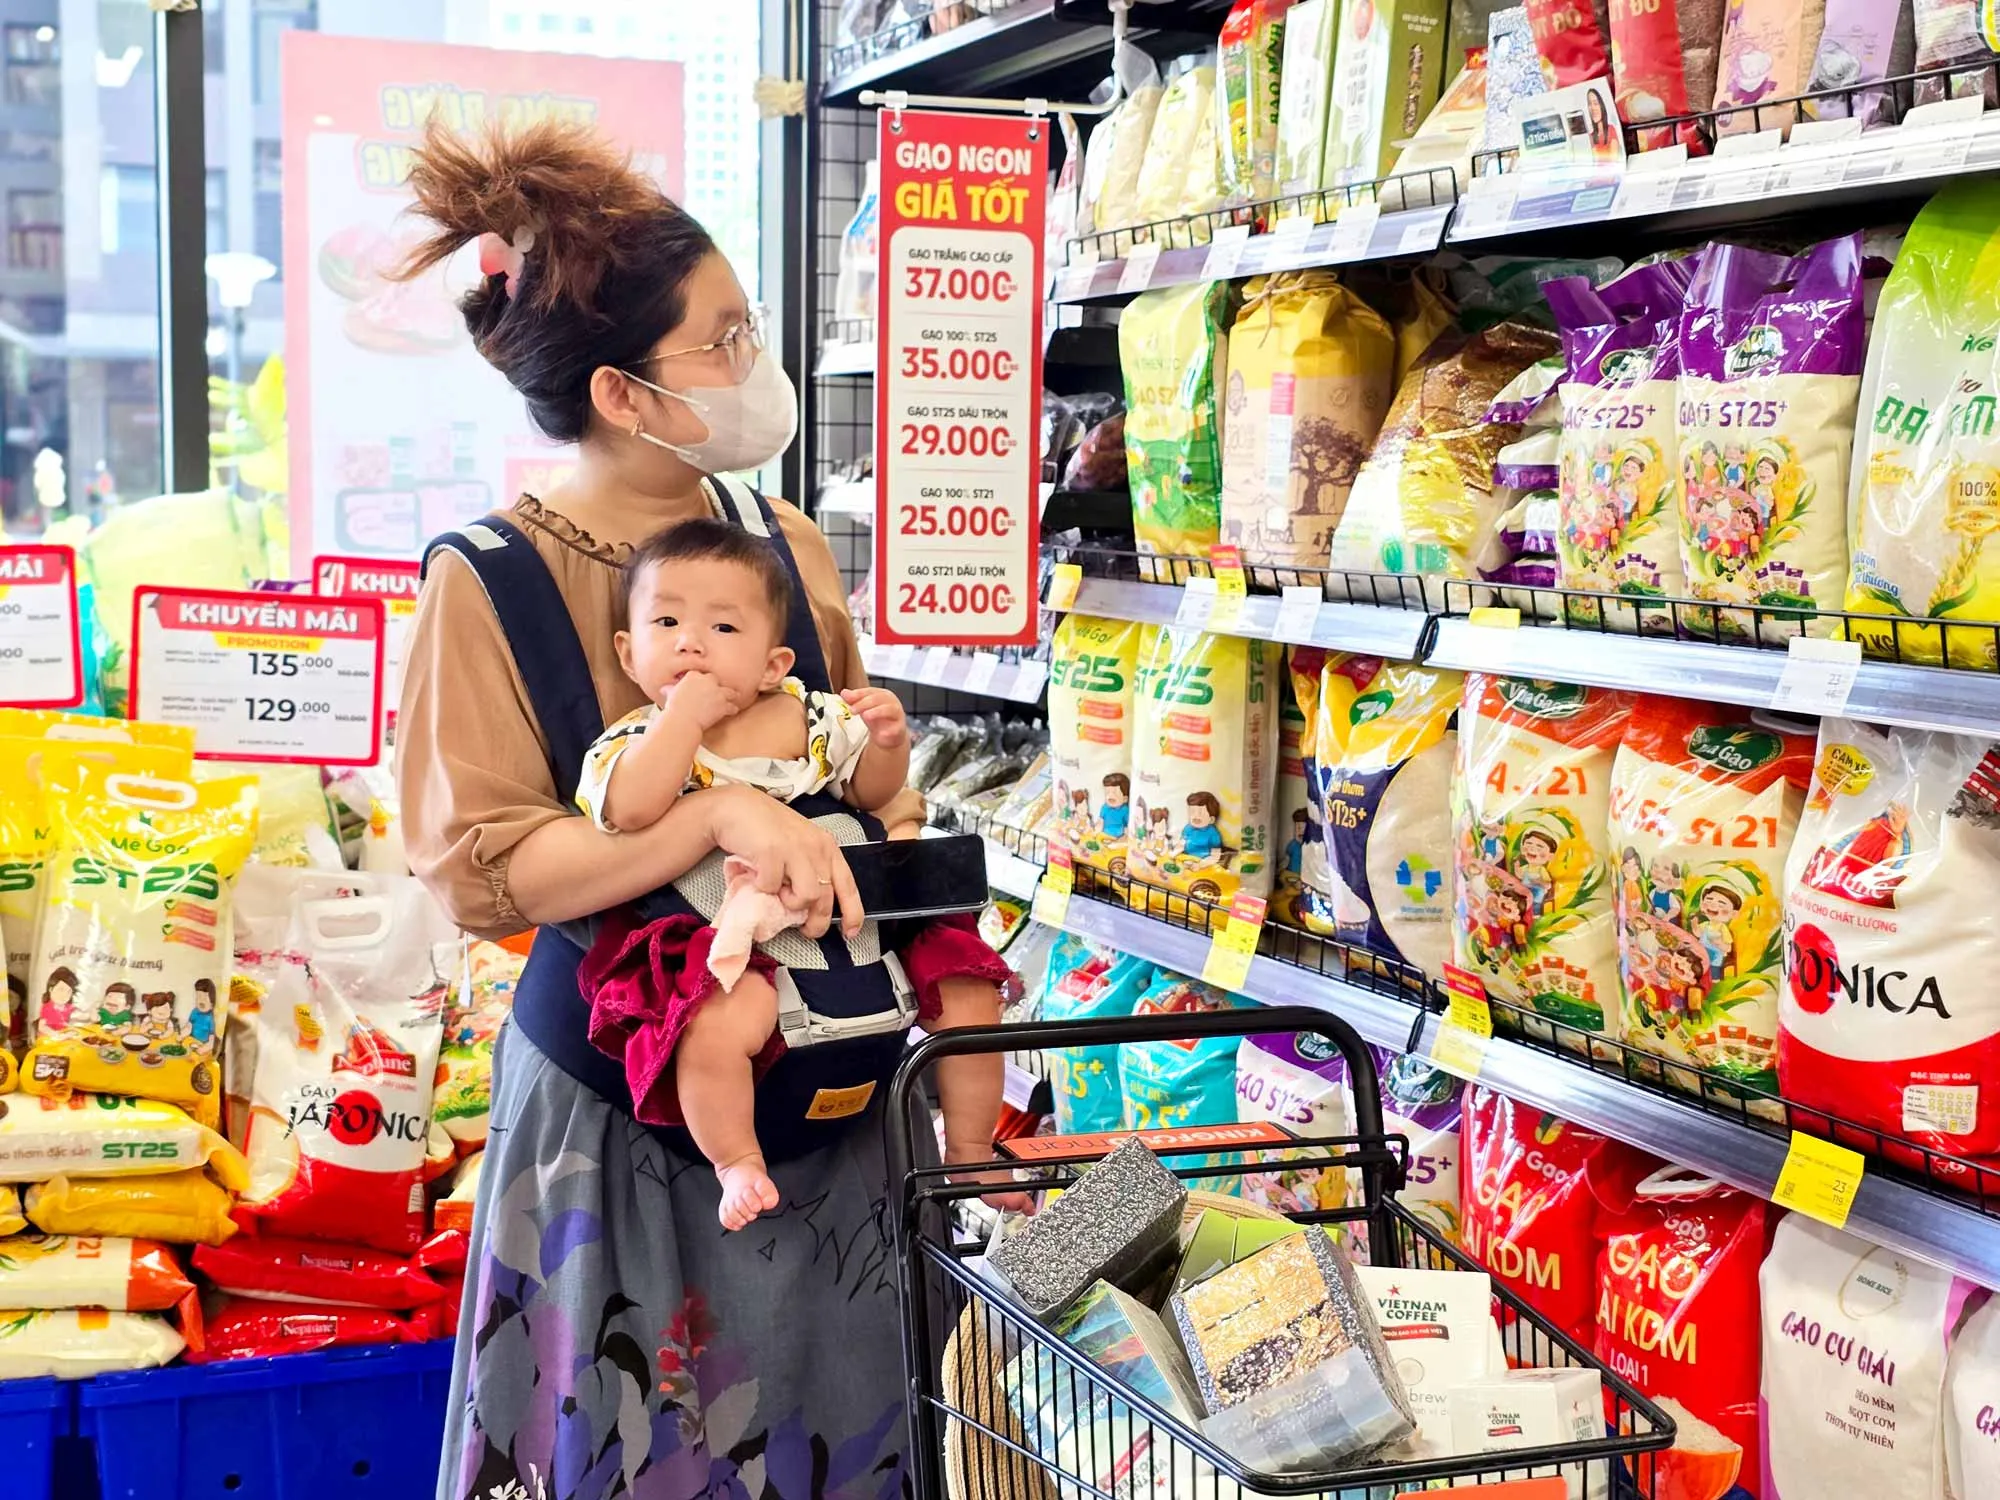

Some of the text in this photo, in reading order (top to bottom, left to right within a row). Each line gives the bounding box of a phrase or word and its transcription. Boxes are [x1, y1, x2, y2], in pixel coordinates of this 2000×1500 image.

[895, 141, 1032, 175] GẠO NGON
[895, 175, 1030, 224] GIÁ TỐT
[969, 251, 990, 262] CAO
[973, 331, 998, 343] ST25
[932, 406, 956, 418] ST25
[1719, 400, 1788, 428] ST25+
[973, 488, 994, 499] ST21
[1958, 481, 1997, 497] 100%
[932, 565, 954, 576] ST21
[351, 572, 420, 595] KHUY
[179, 601, 359, 633] KHUYẾN MÃI
[226, 636, 311, 651] PROMOTION
[1717, 744, 1752, 770] Gạo
[72, 857, 219, 901] ST25
[1811, 902, 1829, 918] CHO
[102, 1142, 179, 1159] ST25
[1832, 1179, 1847, 1194] 23
[302, 1253, 350, 1269] Neptune
[1486, 1230, 1561, 1291] KDM
[1608, 1234, 1700, 1300] GẠO
[1856, 1274, 1894, 1296] HOME RICE
[1378, 1298, 1448, 1313] VIETNAM
[1386, 1309, 1438, 1322] COFFEE
[283, 1321, 333, 1337] Neptune
[1624, 1300, 1697, 1365] KDM
[1781, 1311, 1822, 1347] GẠO
[1825, 1331, 1855, 1366] CỰ
[1610, 1347, 1649, 1387] LOẠI 1
[1409, 1389, 1448, 1403] brew
[1871, 1395, 1896, 1413] MỀM
[1487, 1412, 1521, 1420] VIETNAM
[1491, 1418, 1517, 1426] COFFEE
[1571, 1414, 1596, 1430] VIETNAM
[1872, 1415, 1896, 1432] CƠM
[1575, 1427, 1593, 1441] COFFEE
[1824, 1411, 1895, 1450] THƠM TỰ NHIÊN
